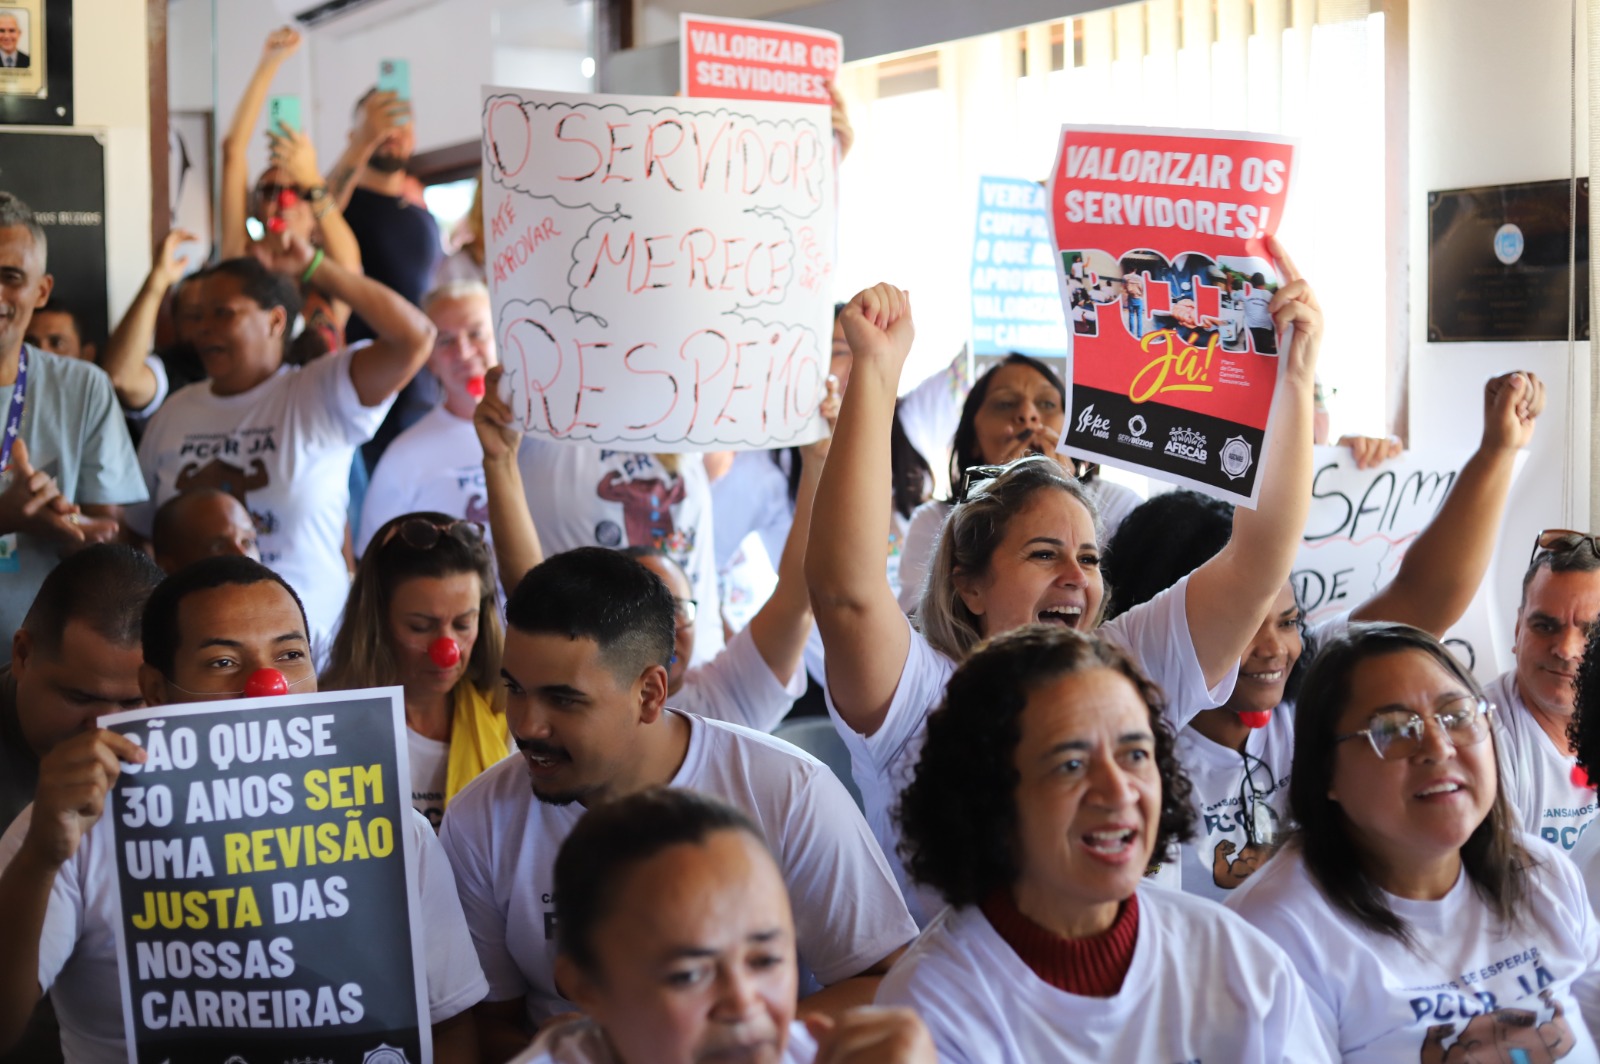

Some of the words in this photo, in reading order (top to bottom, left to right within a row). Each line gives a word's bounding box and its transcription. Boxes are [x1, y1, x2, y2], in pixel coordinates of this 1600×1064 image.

[690, 30, 808, 68] VALORIZAR
[811, 45, 838, 71] OS
[488, 101, 531, 178] O
[1064, 145, 1233, 190] VALORIZAR
[1240, 157, 1286, 195] OS
[1064, 189, 1271, 240] SERVIDORES!
[493, 217, 562, 295] APROVAR
[584, 228, 788, 297] MERECE
[1129, 329, 1219, 403] Já!
[1164, 440, 1208, 461] AFISCAB
[1293, 568, 1355, 613] DE
[208, 714, 337, 771] QUASE
[121, 784, 173, 828] 30
[185, 773, 294, 825] ANOS
[303, 764, 384, 811] SEM
[125, 836, 215, 880] UMA
[224, 809, 395, 875] REVISÃO
[131, 886, 263, 930] JUSTA
[271, 875, 350, 925] DAS
[135, 936, 296, 980] NOSSAS
[1480, 946, 1541, 980] ESPERAR
[141, 982, 365, 1030] CARREIRAS
